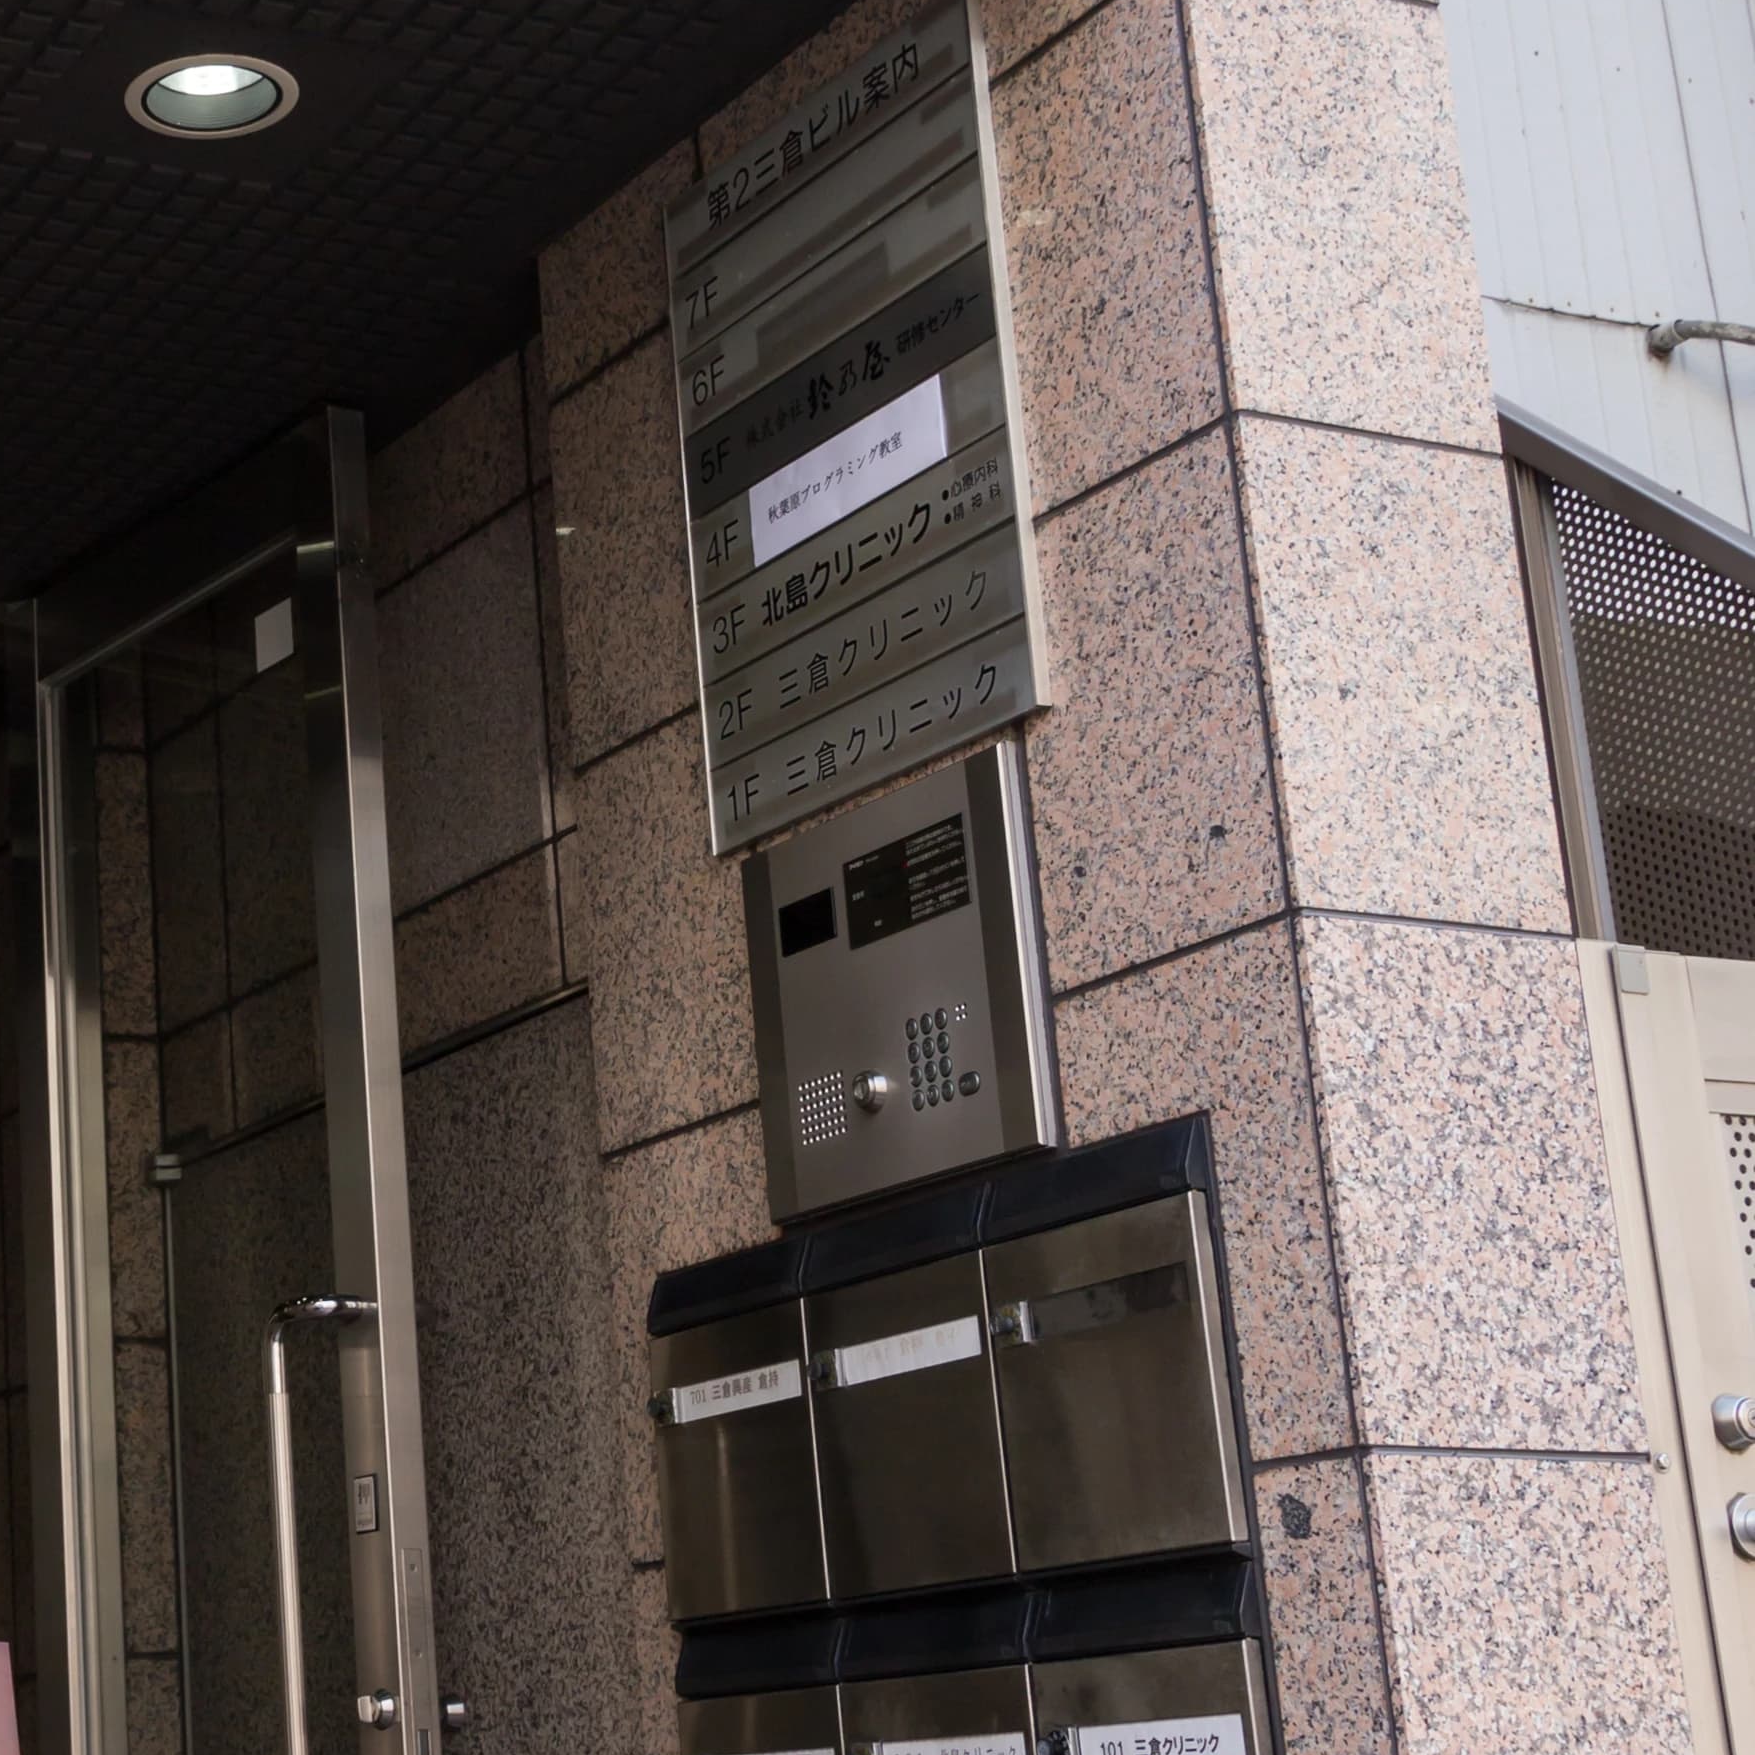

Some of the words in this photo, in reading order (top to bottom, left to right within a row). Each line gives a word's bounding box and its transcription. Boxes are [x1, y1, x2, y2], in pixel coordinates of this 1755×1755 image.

[707, 43, 920, 231] 第2三倉ビル案内
[685, 275, 718, 329] 7F
[692, 354, 725, 406] 6F
[701, 437, 730, 484] 5F
[706, 519, 738, 567] 4F
[767, 431, 903, 524] 秋葉原プログラミング教室
[712, 604, 745, 654] 3F
[762, 503, 931, 627] 北島クリニック
[719, 688, 752, 741] 2F
[779, 570, 987, 709] 三倉クリニック
[727, 773, 760, 821] 1F
[787, 663, 997, 795] 三倉クリニック
